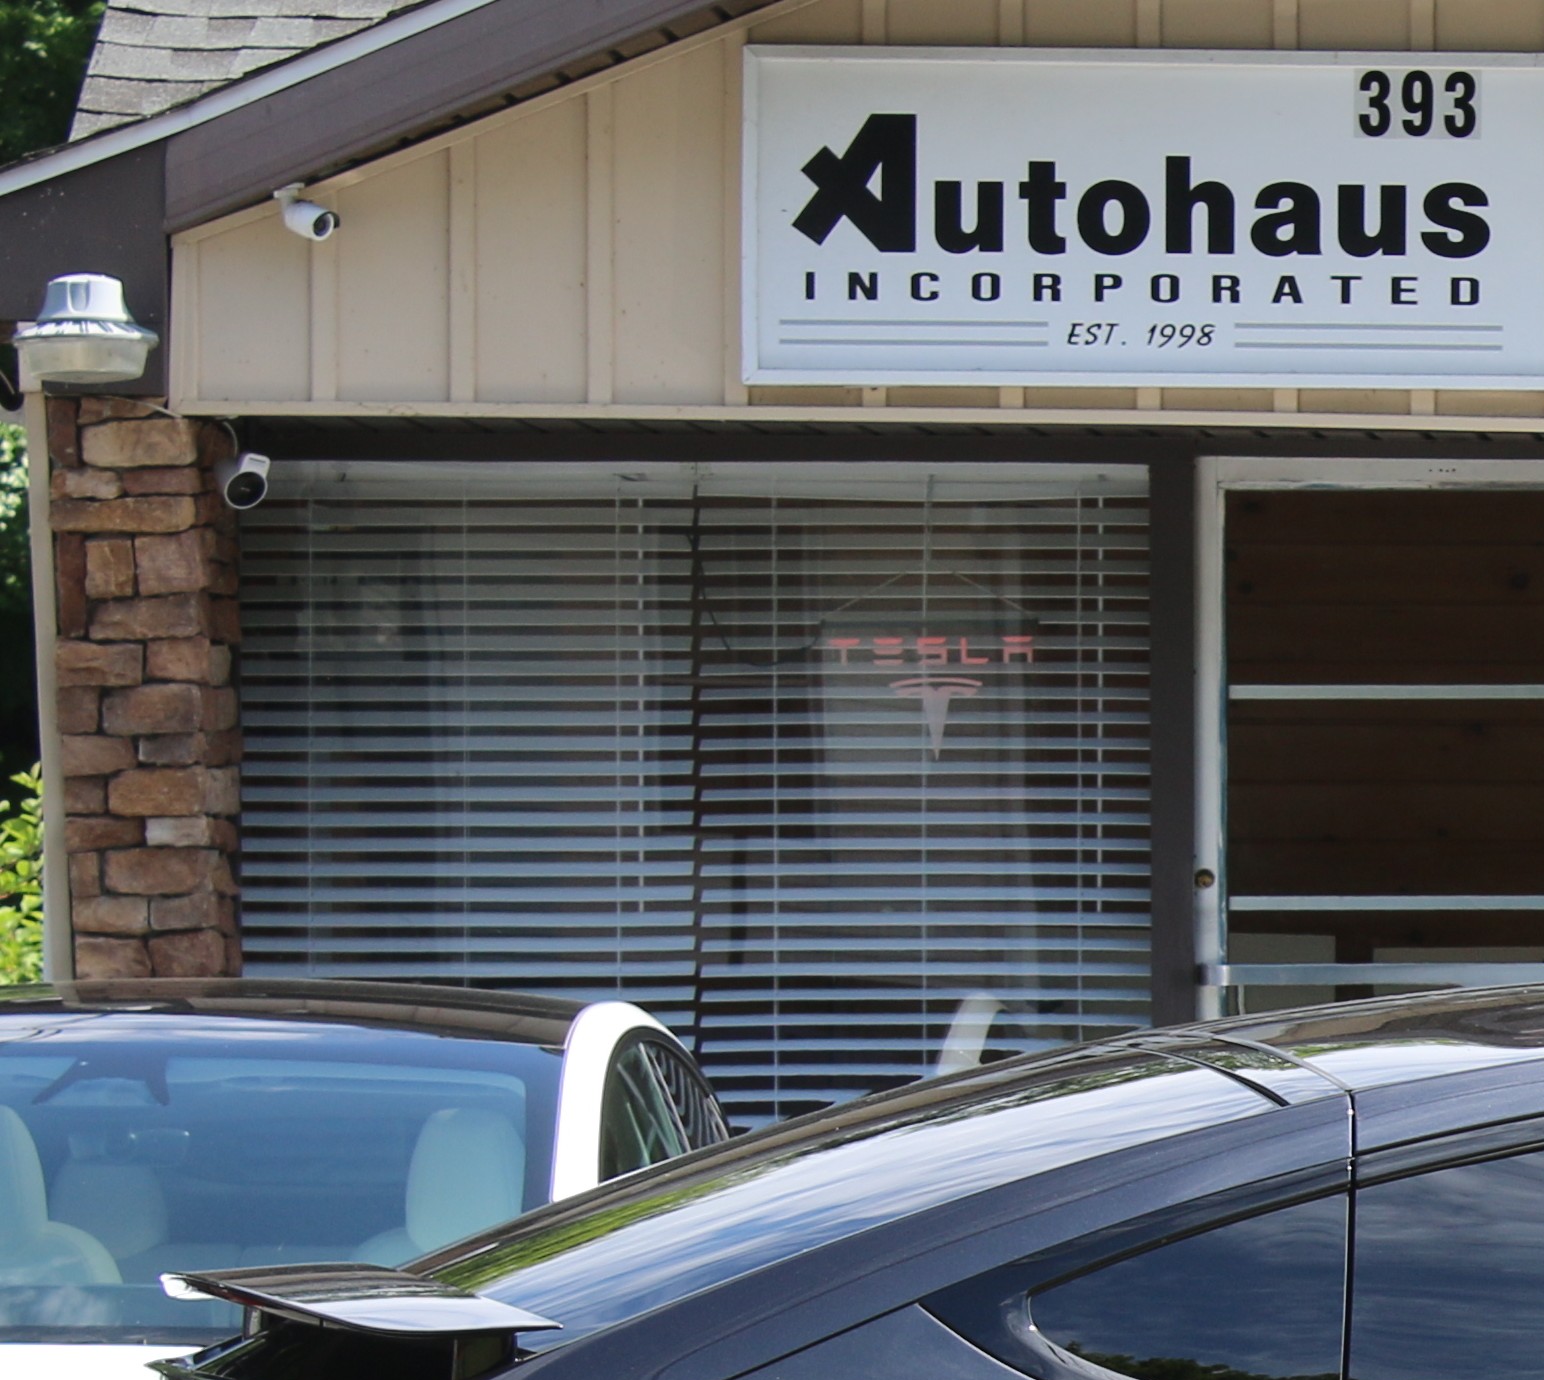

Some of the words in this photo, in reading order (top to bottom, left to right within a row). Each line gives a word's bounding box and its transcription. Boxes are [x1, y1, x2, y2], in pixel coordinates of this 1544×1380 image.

[1358, 70, 1476, 138] 393
[792, 113, 1491, 259] Autohaus
[805, 271, 1480, 306] INCORPORATED
[1067, 323, 1127, 347] EST.
[1147, 323, 1216, 348] 1998
[828, 636, 1034, 666] TESLA
